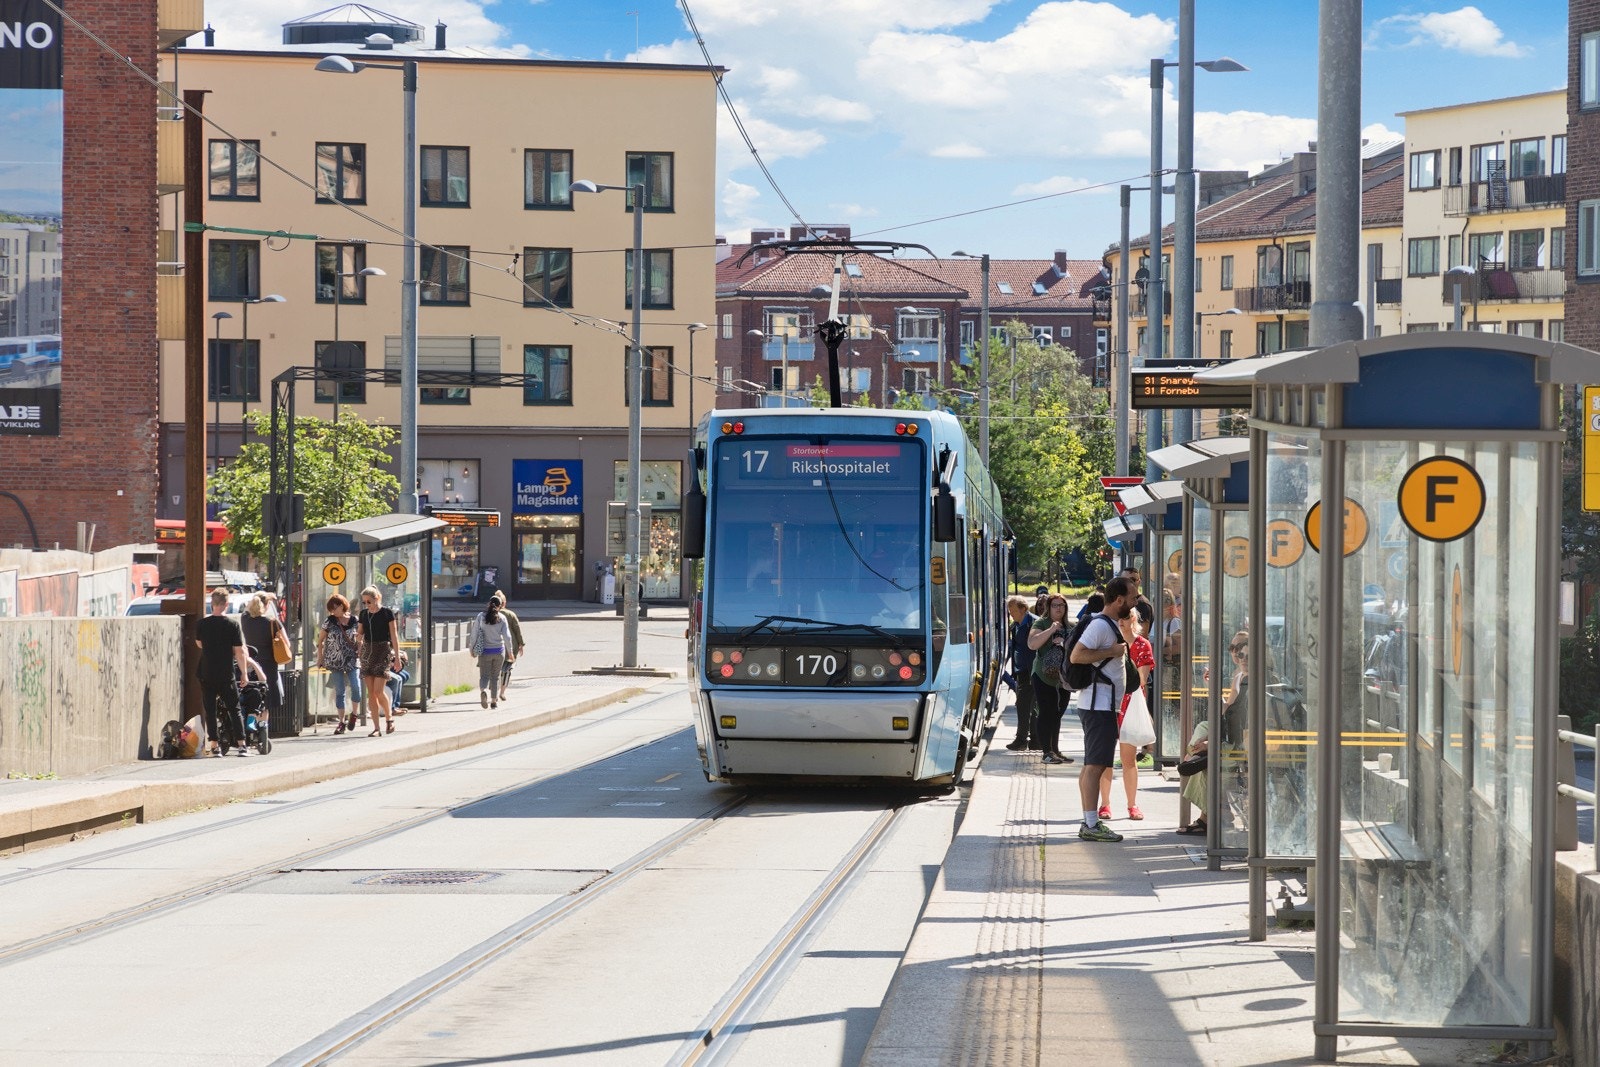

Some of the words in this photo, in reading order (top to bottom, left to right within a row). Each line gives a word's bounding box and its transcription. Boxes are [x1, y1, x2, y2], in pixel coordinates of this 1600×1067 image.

[0, 21, 53, 49] NO
[1144, 376, 1155, 385] 31
[1144, 386, 1155, 395] 31
[1160, 386, 1200, 395] Fornebu
[793, 447, 829, 455] Stortorvet
[742, 450, 769, 473] 17
[792, 460, 891, 476] Rikshospitalet
[517, 482, 557, 496] Lampe
[517, 494, 579, 508] Magasinet
[1426, 475, 1458, 523] F
[1271, 529, 1291, 558] F
[1230, 545, 1247, 570] F
[329, 567, 340, 580] C
[392, 567, 402, 580] C
[795, 654, 837, 676] 170
